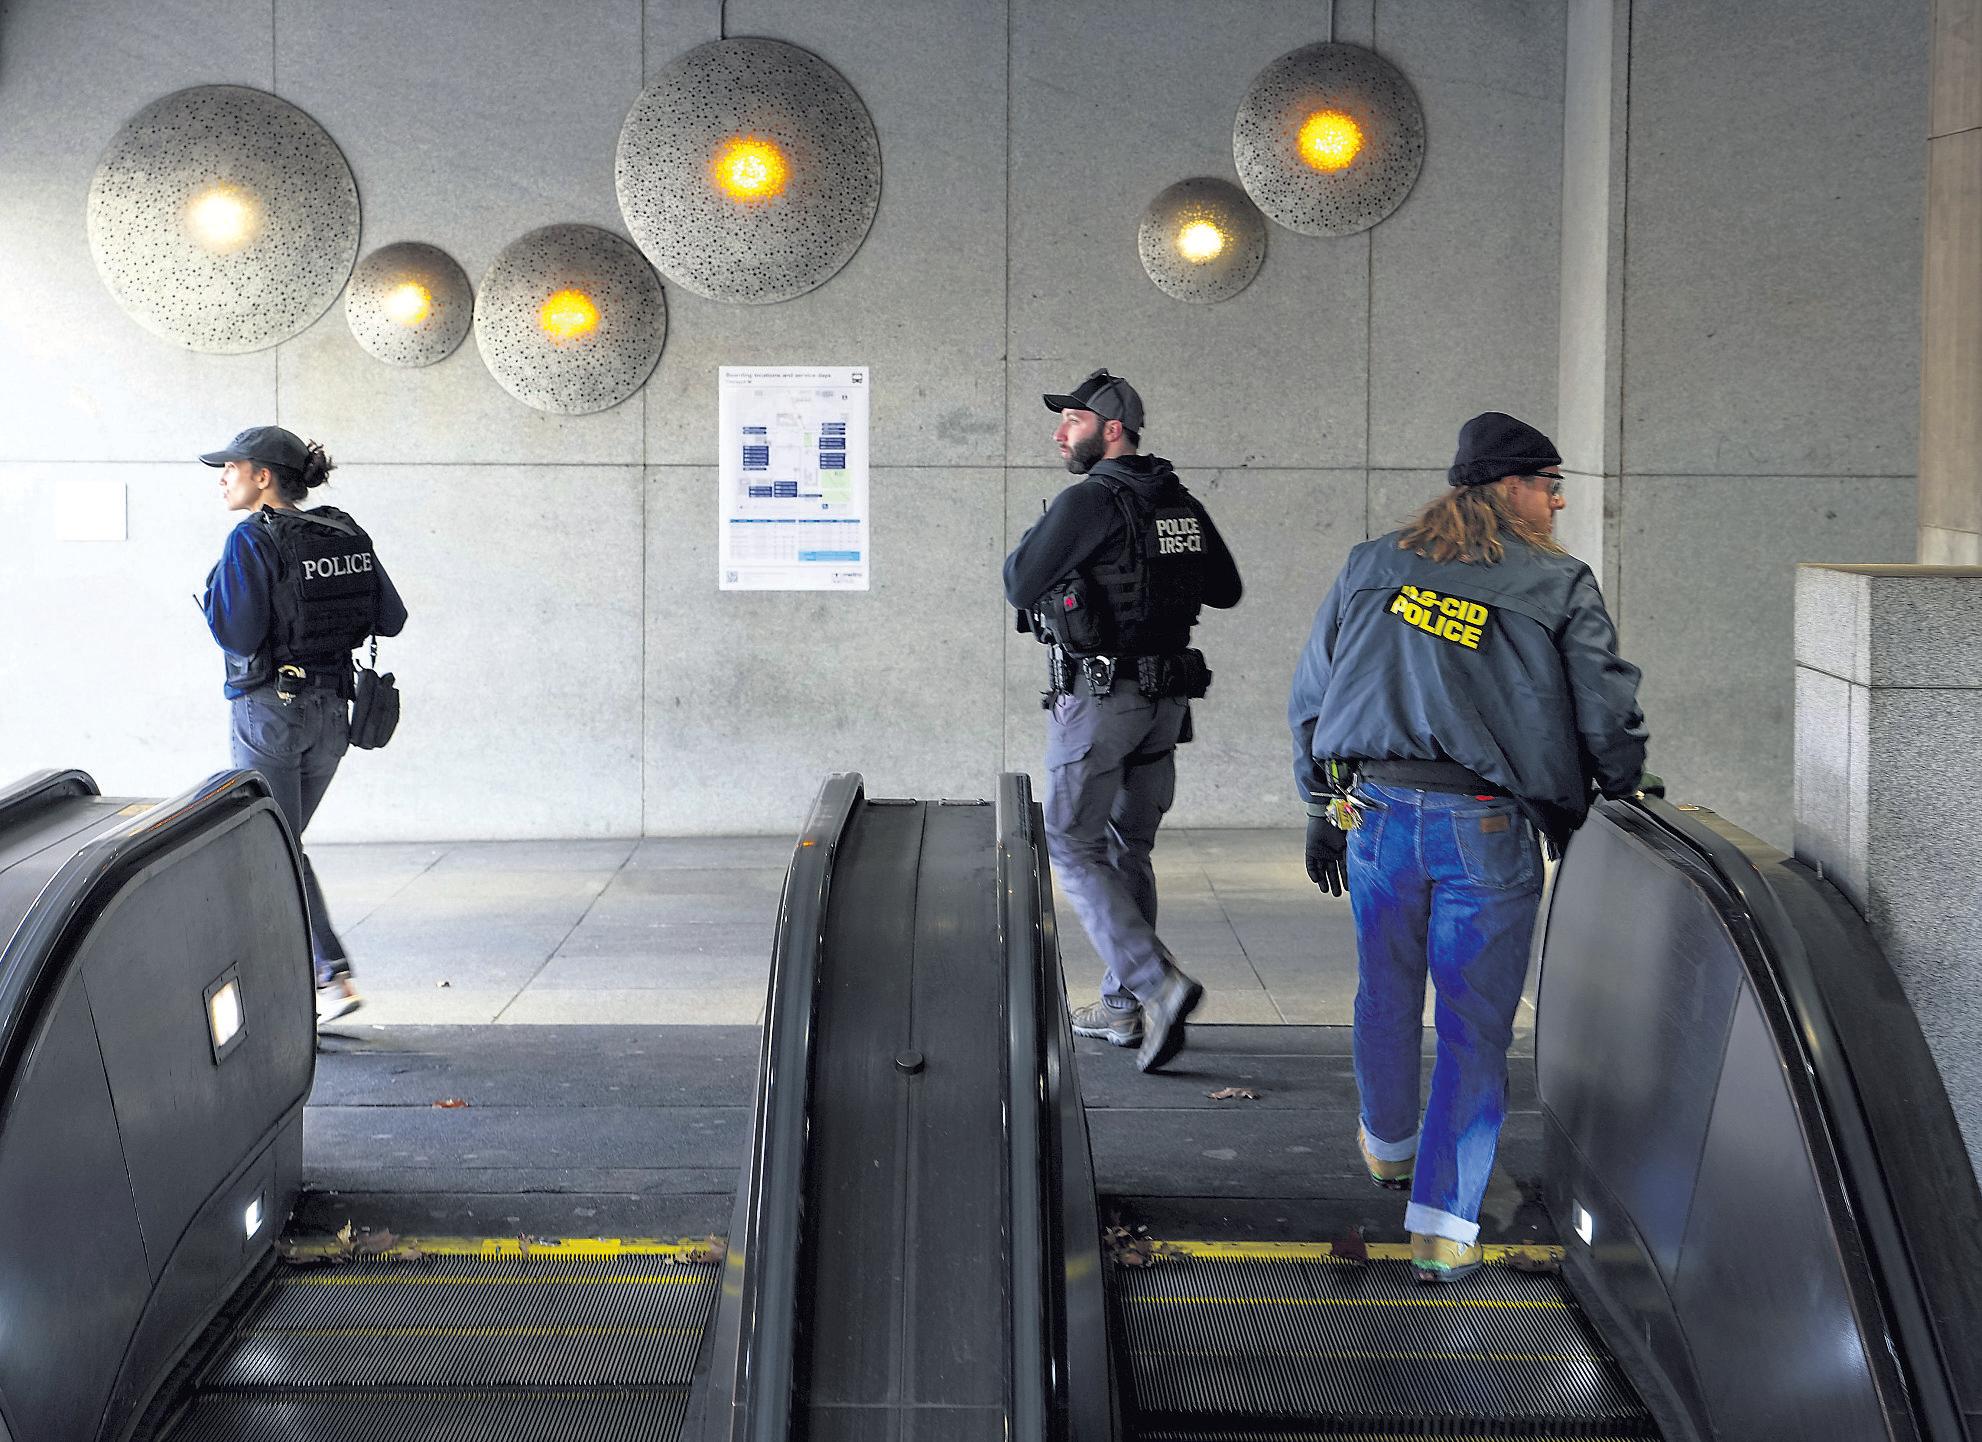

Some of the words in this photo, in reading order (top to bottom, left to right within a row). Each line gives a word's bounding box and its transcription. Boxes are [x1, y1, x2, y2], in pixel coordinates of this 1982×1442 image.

[1156, 518, 1201, 536] POLICE
[1159, 535, 1202, 554] IRS-CI
[302, 553, 373, 580] POLICE
[1390, 595, 1483, 649] POLICE
